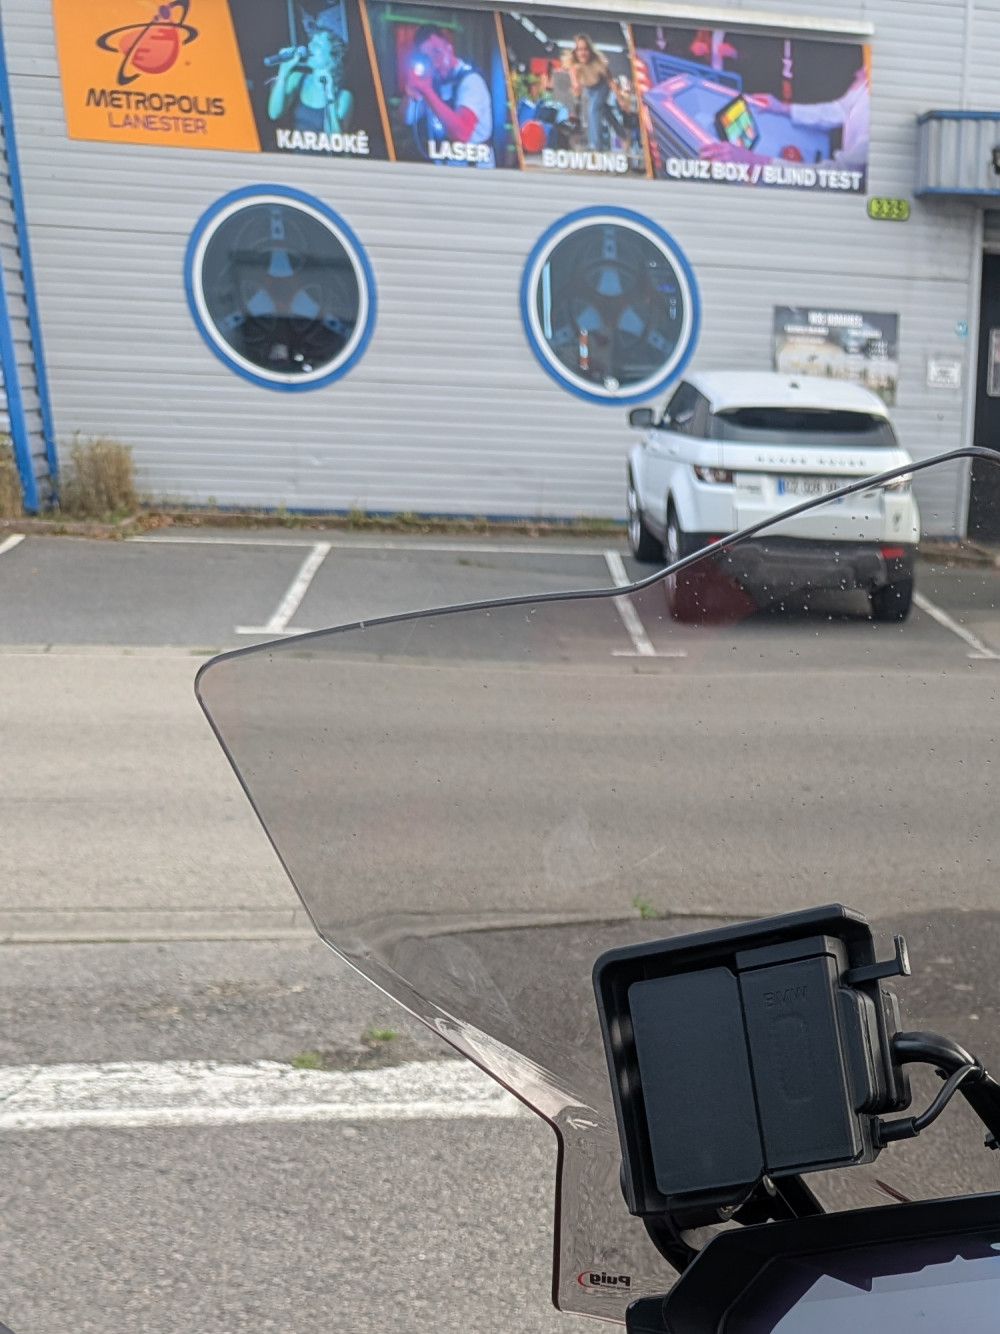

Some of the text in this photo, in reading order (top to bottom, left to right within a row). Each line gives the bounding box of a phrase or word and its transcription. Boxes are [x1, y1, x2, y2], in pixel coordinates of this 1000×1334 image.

[85, 87, 226, 117] METROPOLIS
[108, 112, 208, 135] LANESTER
[276, 129, 370, 155] KARAOKÉ
[428, 139, 490, 163] LASER
[542, 149, 629, 173] BOWLING
[666, 157, 863, 191] QUIZ BOX / BLIND TEST
[762, 985, 809, 1008] BMW
